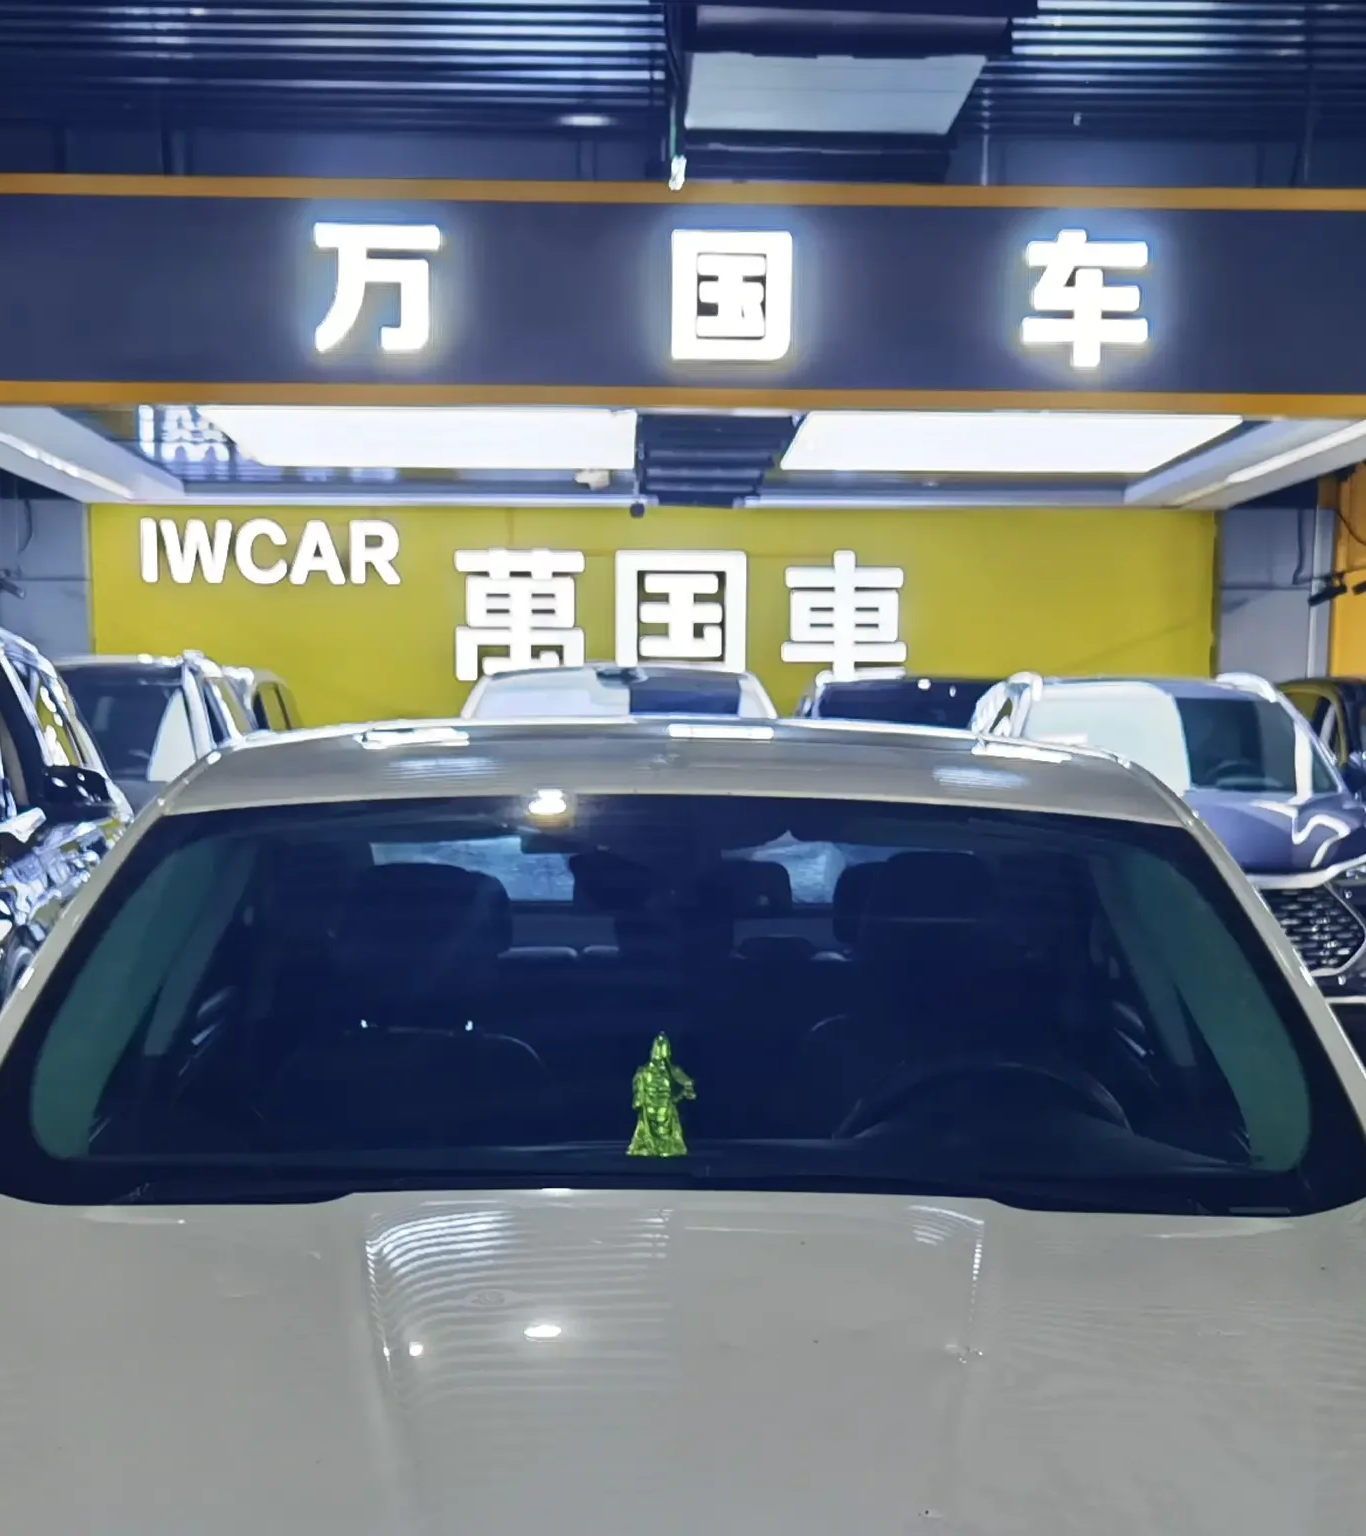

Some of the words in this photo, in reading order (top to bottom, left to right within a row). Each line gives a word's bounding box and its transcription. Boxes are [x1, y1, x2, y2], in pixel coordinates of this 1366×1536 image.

[313, 221, 1149, 368] 万国车
[140, 517, 401, 586] IWCAR
